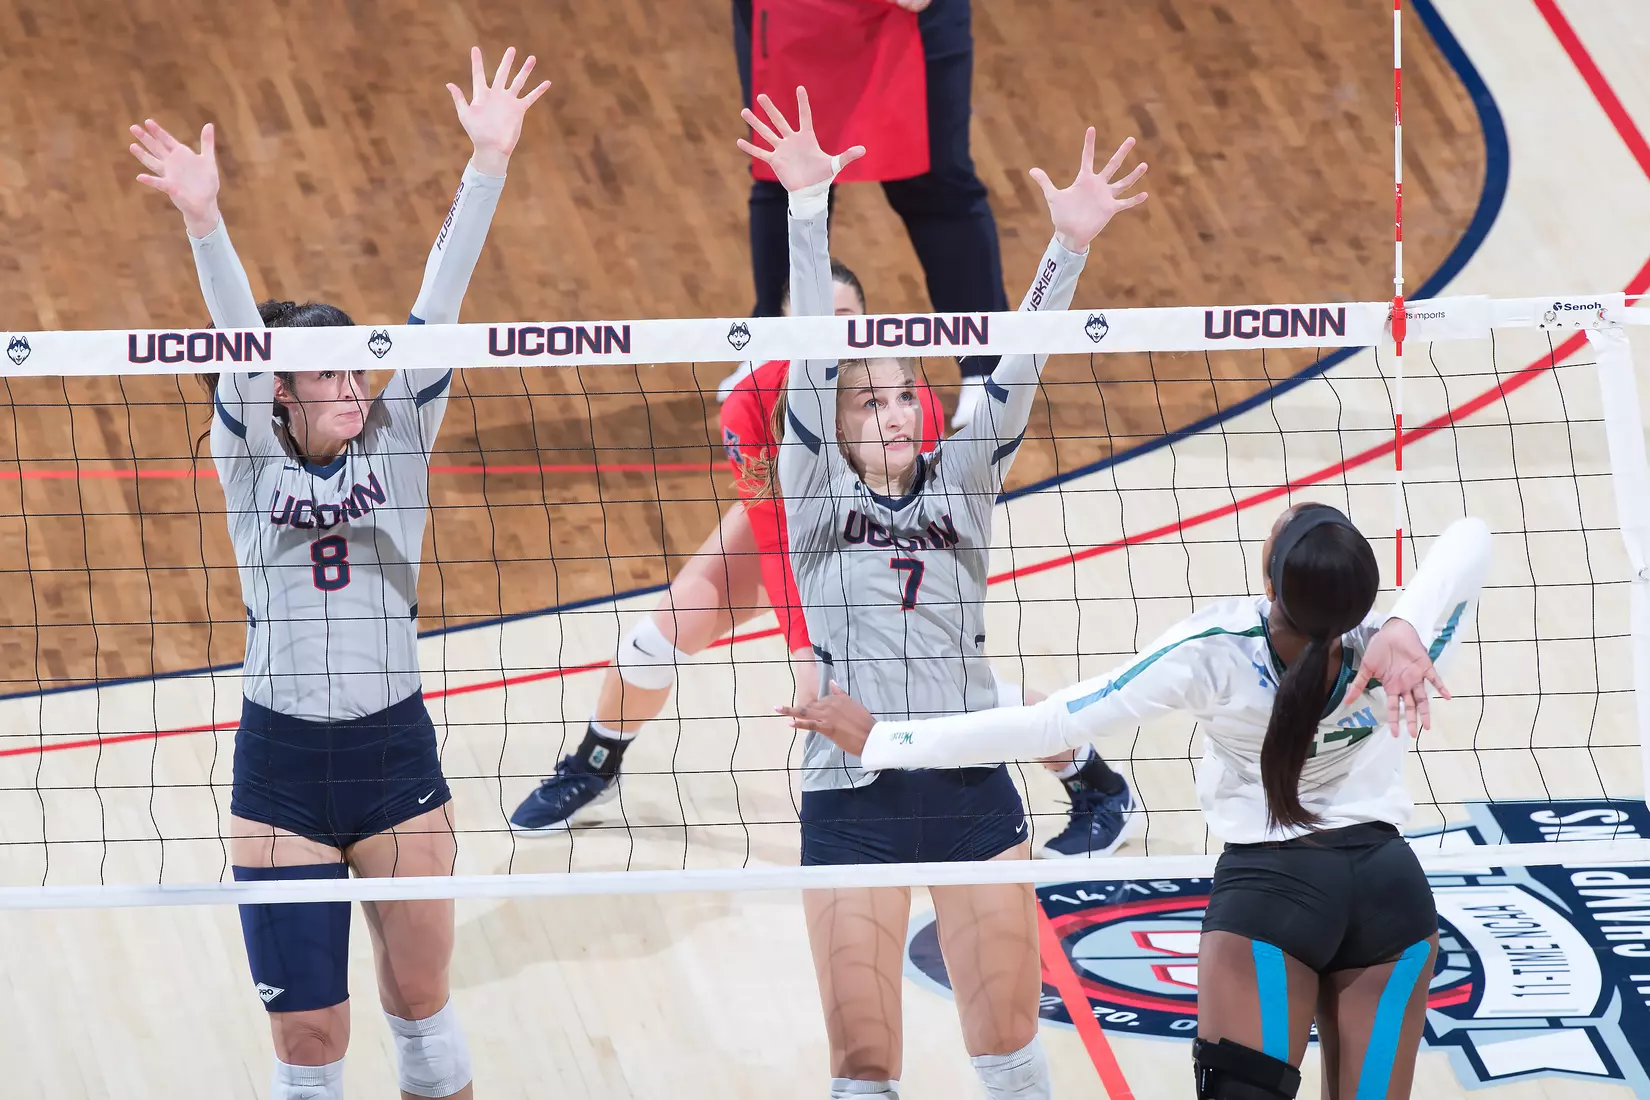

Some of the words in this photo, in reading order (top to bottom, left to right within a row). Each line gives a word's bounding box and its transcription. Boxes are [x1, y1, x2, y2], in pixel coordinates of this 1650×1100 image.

[1027, 258, 1057, 312] USKIES
[1204, 307, 1346, 340] UCONN
[1564, 301, 1602, 311] Senoh
[128, 331, 272, 364] UCONN
[488, 324, 632, 357] UCONN
[847, 315, 989, 349] UCONN
[270, 471, 387, 530] UCONN
[310, 534, 351, 592] 8
[889, 557, 925, 611] 7
[1462, 904, 1552, 939] NCAA
[1501, 943, 1572, 998] 11-TIME
